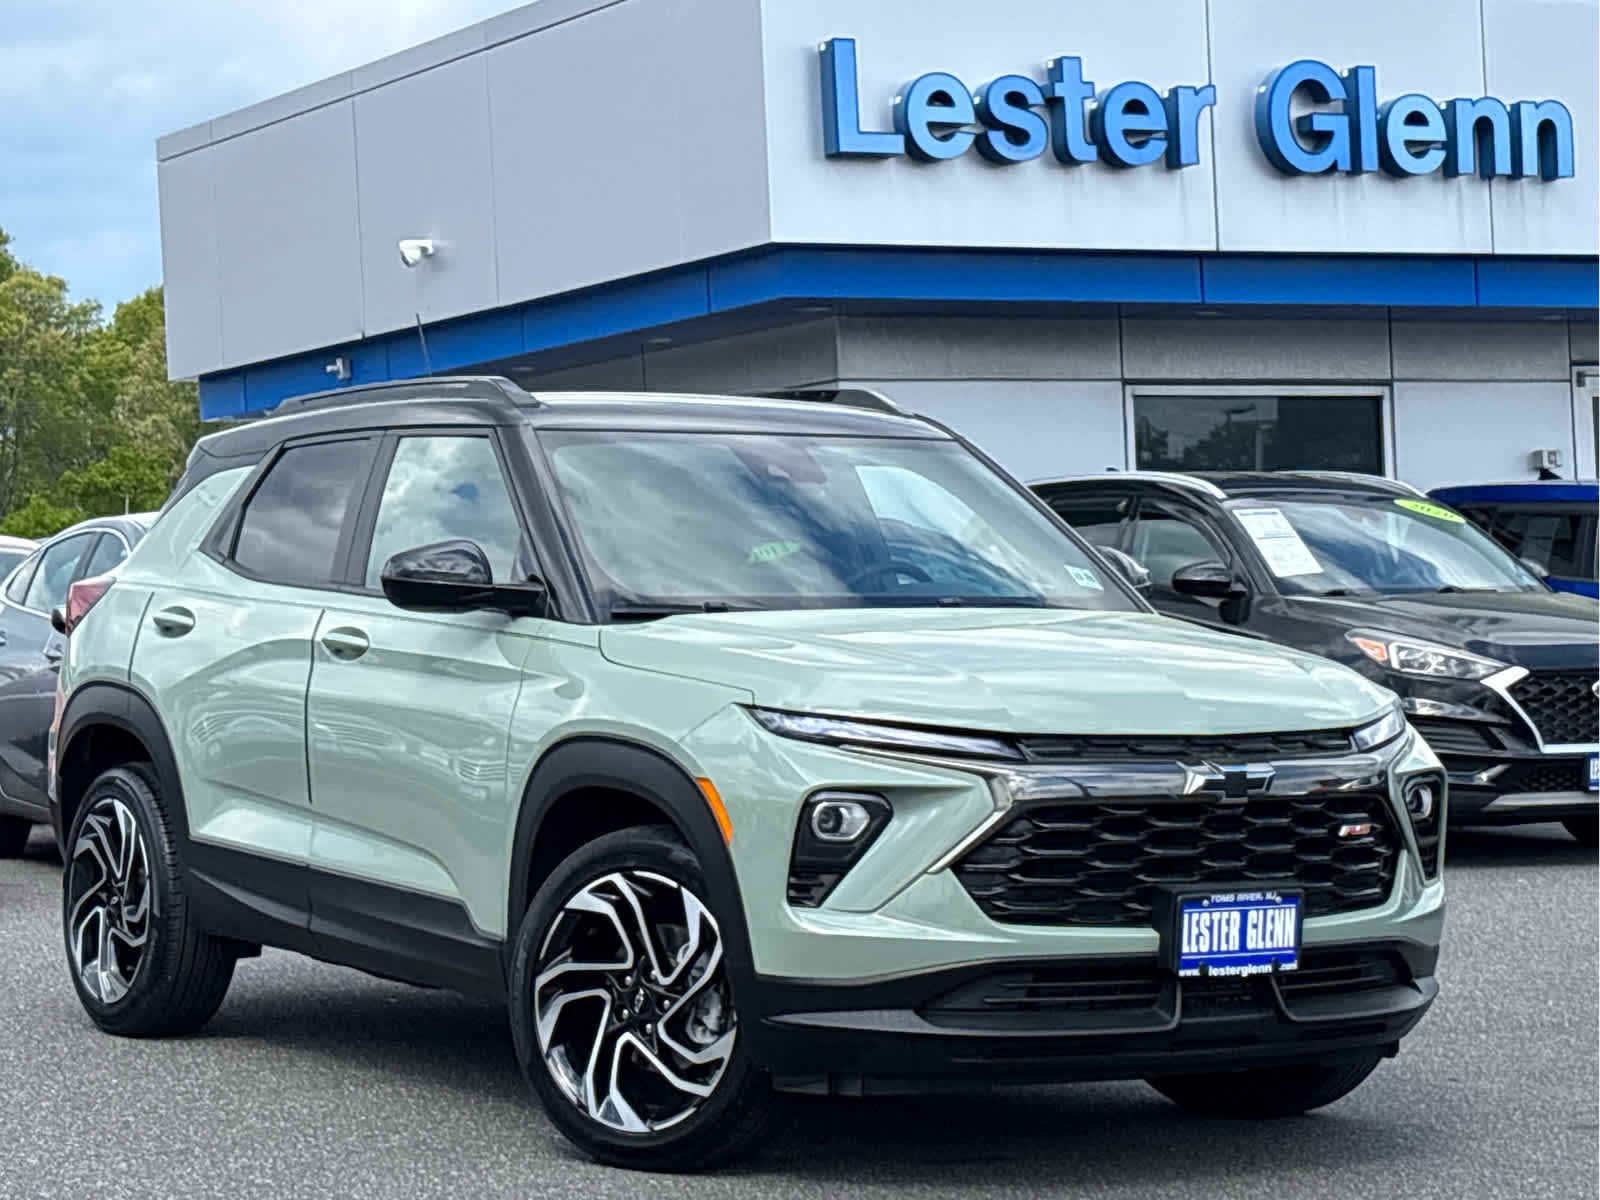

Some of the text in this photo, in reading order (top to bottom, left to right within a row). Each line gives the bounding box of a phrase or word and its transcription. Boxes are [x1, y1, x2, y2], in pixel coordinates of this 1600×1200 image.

[819, 37, 1575, 181] Lester Glenn
[1210, 893, 1235, 904] TOMS
[1182, 907, 1296, 953] LESTER GLENN
